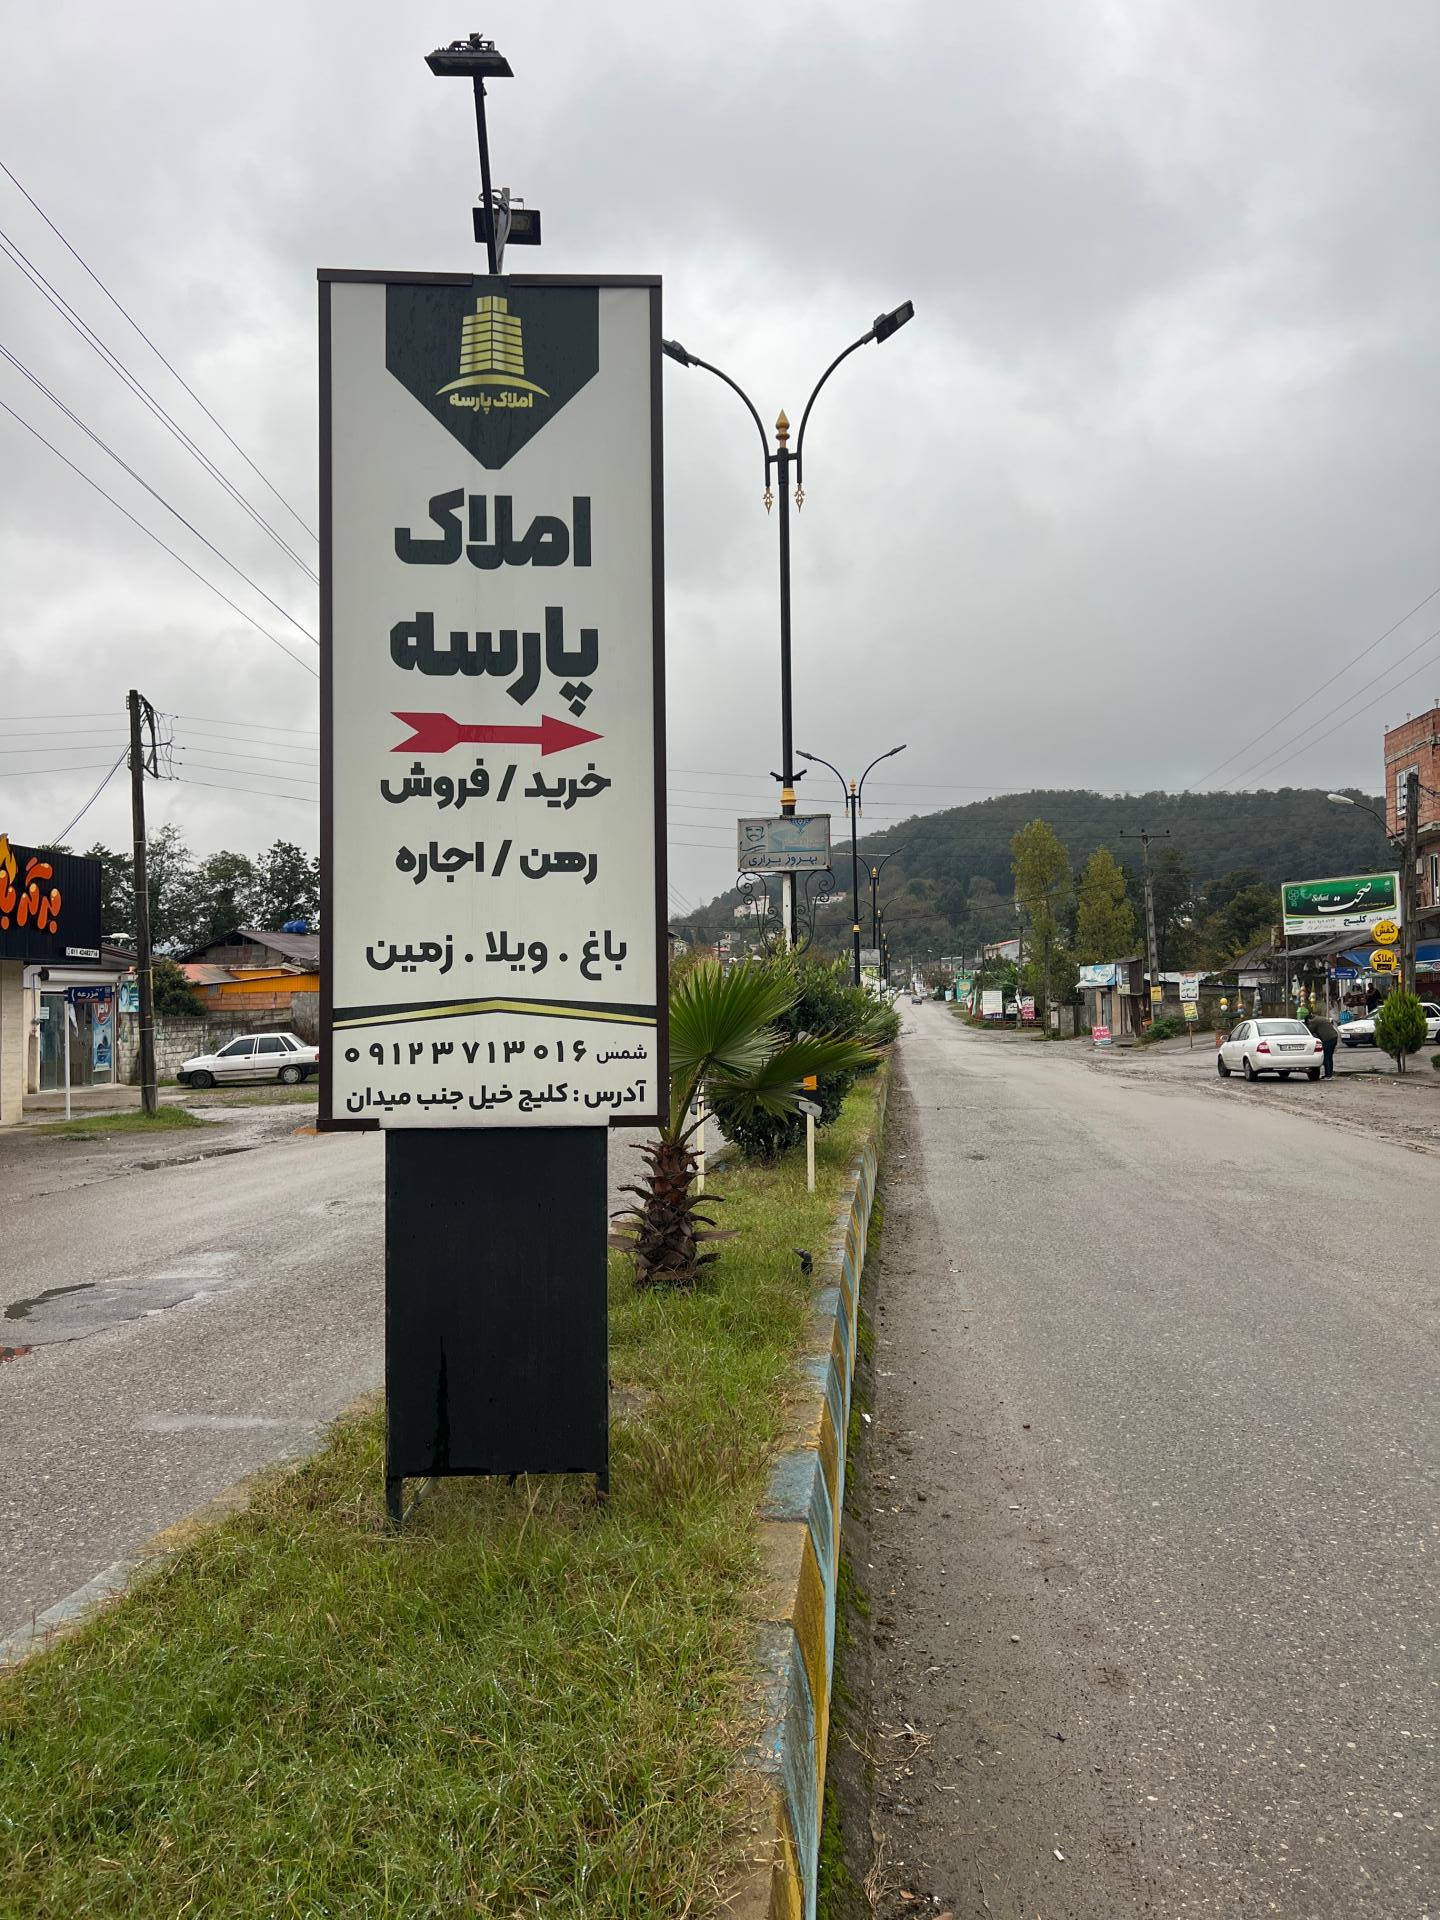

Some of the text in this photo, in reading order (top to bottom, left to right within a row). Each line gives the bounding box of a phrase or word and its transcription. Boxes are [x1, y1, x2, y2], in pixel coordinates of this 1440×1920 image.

[449, 391, 534, 414] املاک پارسه
[395, 488, 592, 570] املاک
[390, 607, 599, 718] پارسه
[380, 758, 612, 810] خرید / فروش
[395, 839, 598, 886] رهن / اجاره
[748, 853, 818, 867] بهروز براری
[1375, 925, 1395, 937] کفش
[366, 934, 454, 974] زمین
[485, 931, 548, 974] ویلا
[579, 930, 627, 981] باغ
[1373, 953, 1395, 963] املاک
[77, 990, 99, 999] مزرعه
[596, 1044, 648, 1065] شمس
[346, 1087, 412, 1113] میدان
[416, 1087, 464, 1112] جنب
[468, 1085, 513, 1110] خیل
[518, 1083, 569, 1112] کلیج
